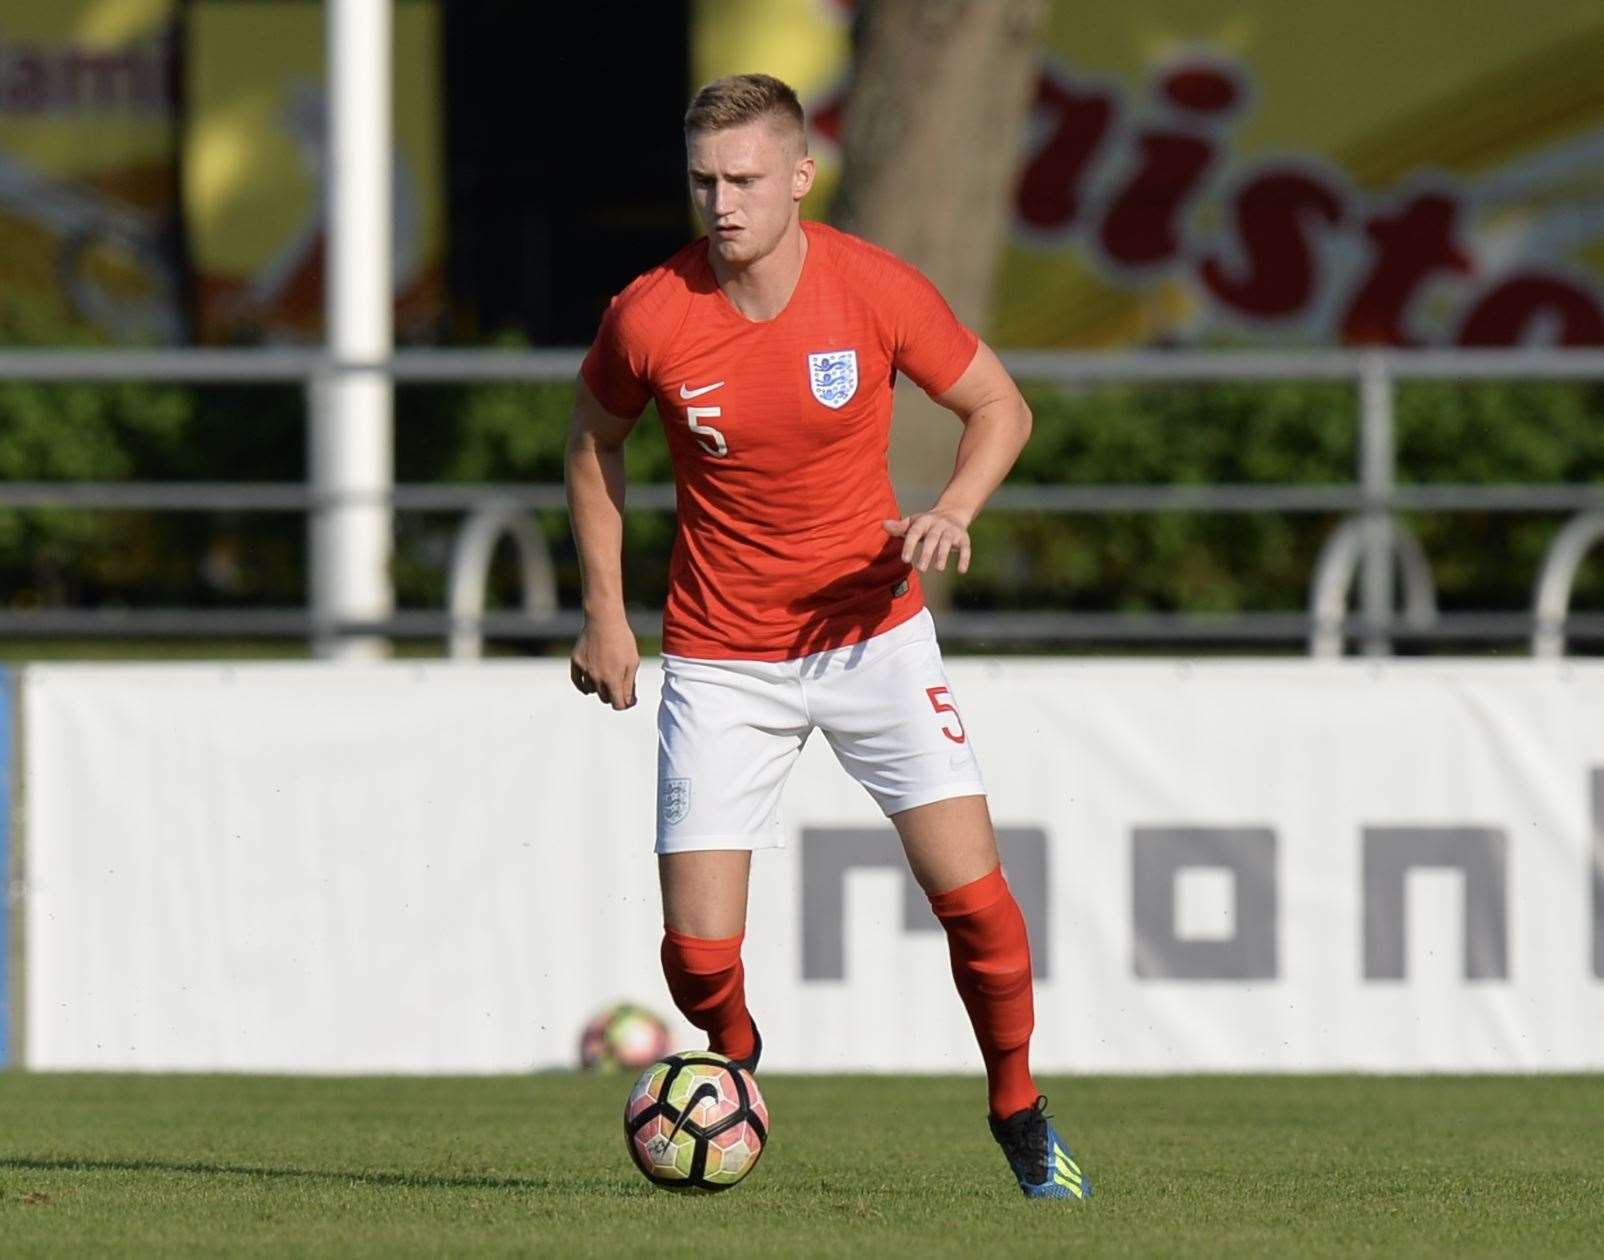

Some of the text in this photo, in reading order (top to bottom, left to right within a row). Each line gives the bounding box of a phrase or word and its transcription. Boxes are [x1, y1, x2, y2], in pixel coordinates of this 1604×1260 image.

[687, 406, 728, 458] 5
[926, 686, 966, 745] 5
[800, 767, 1604, 982] mon
